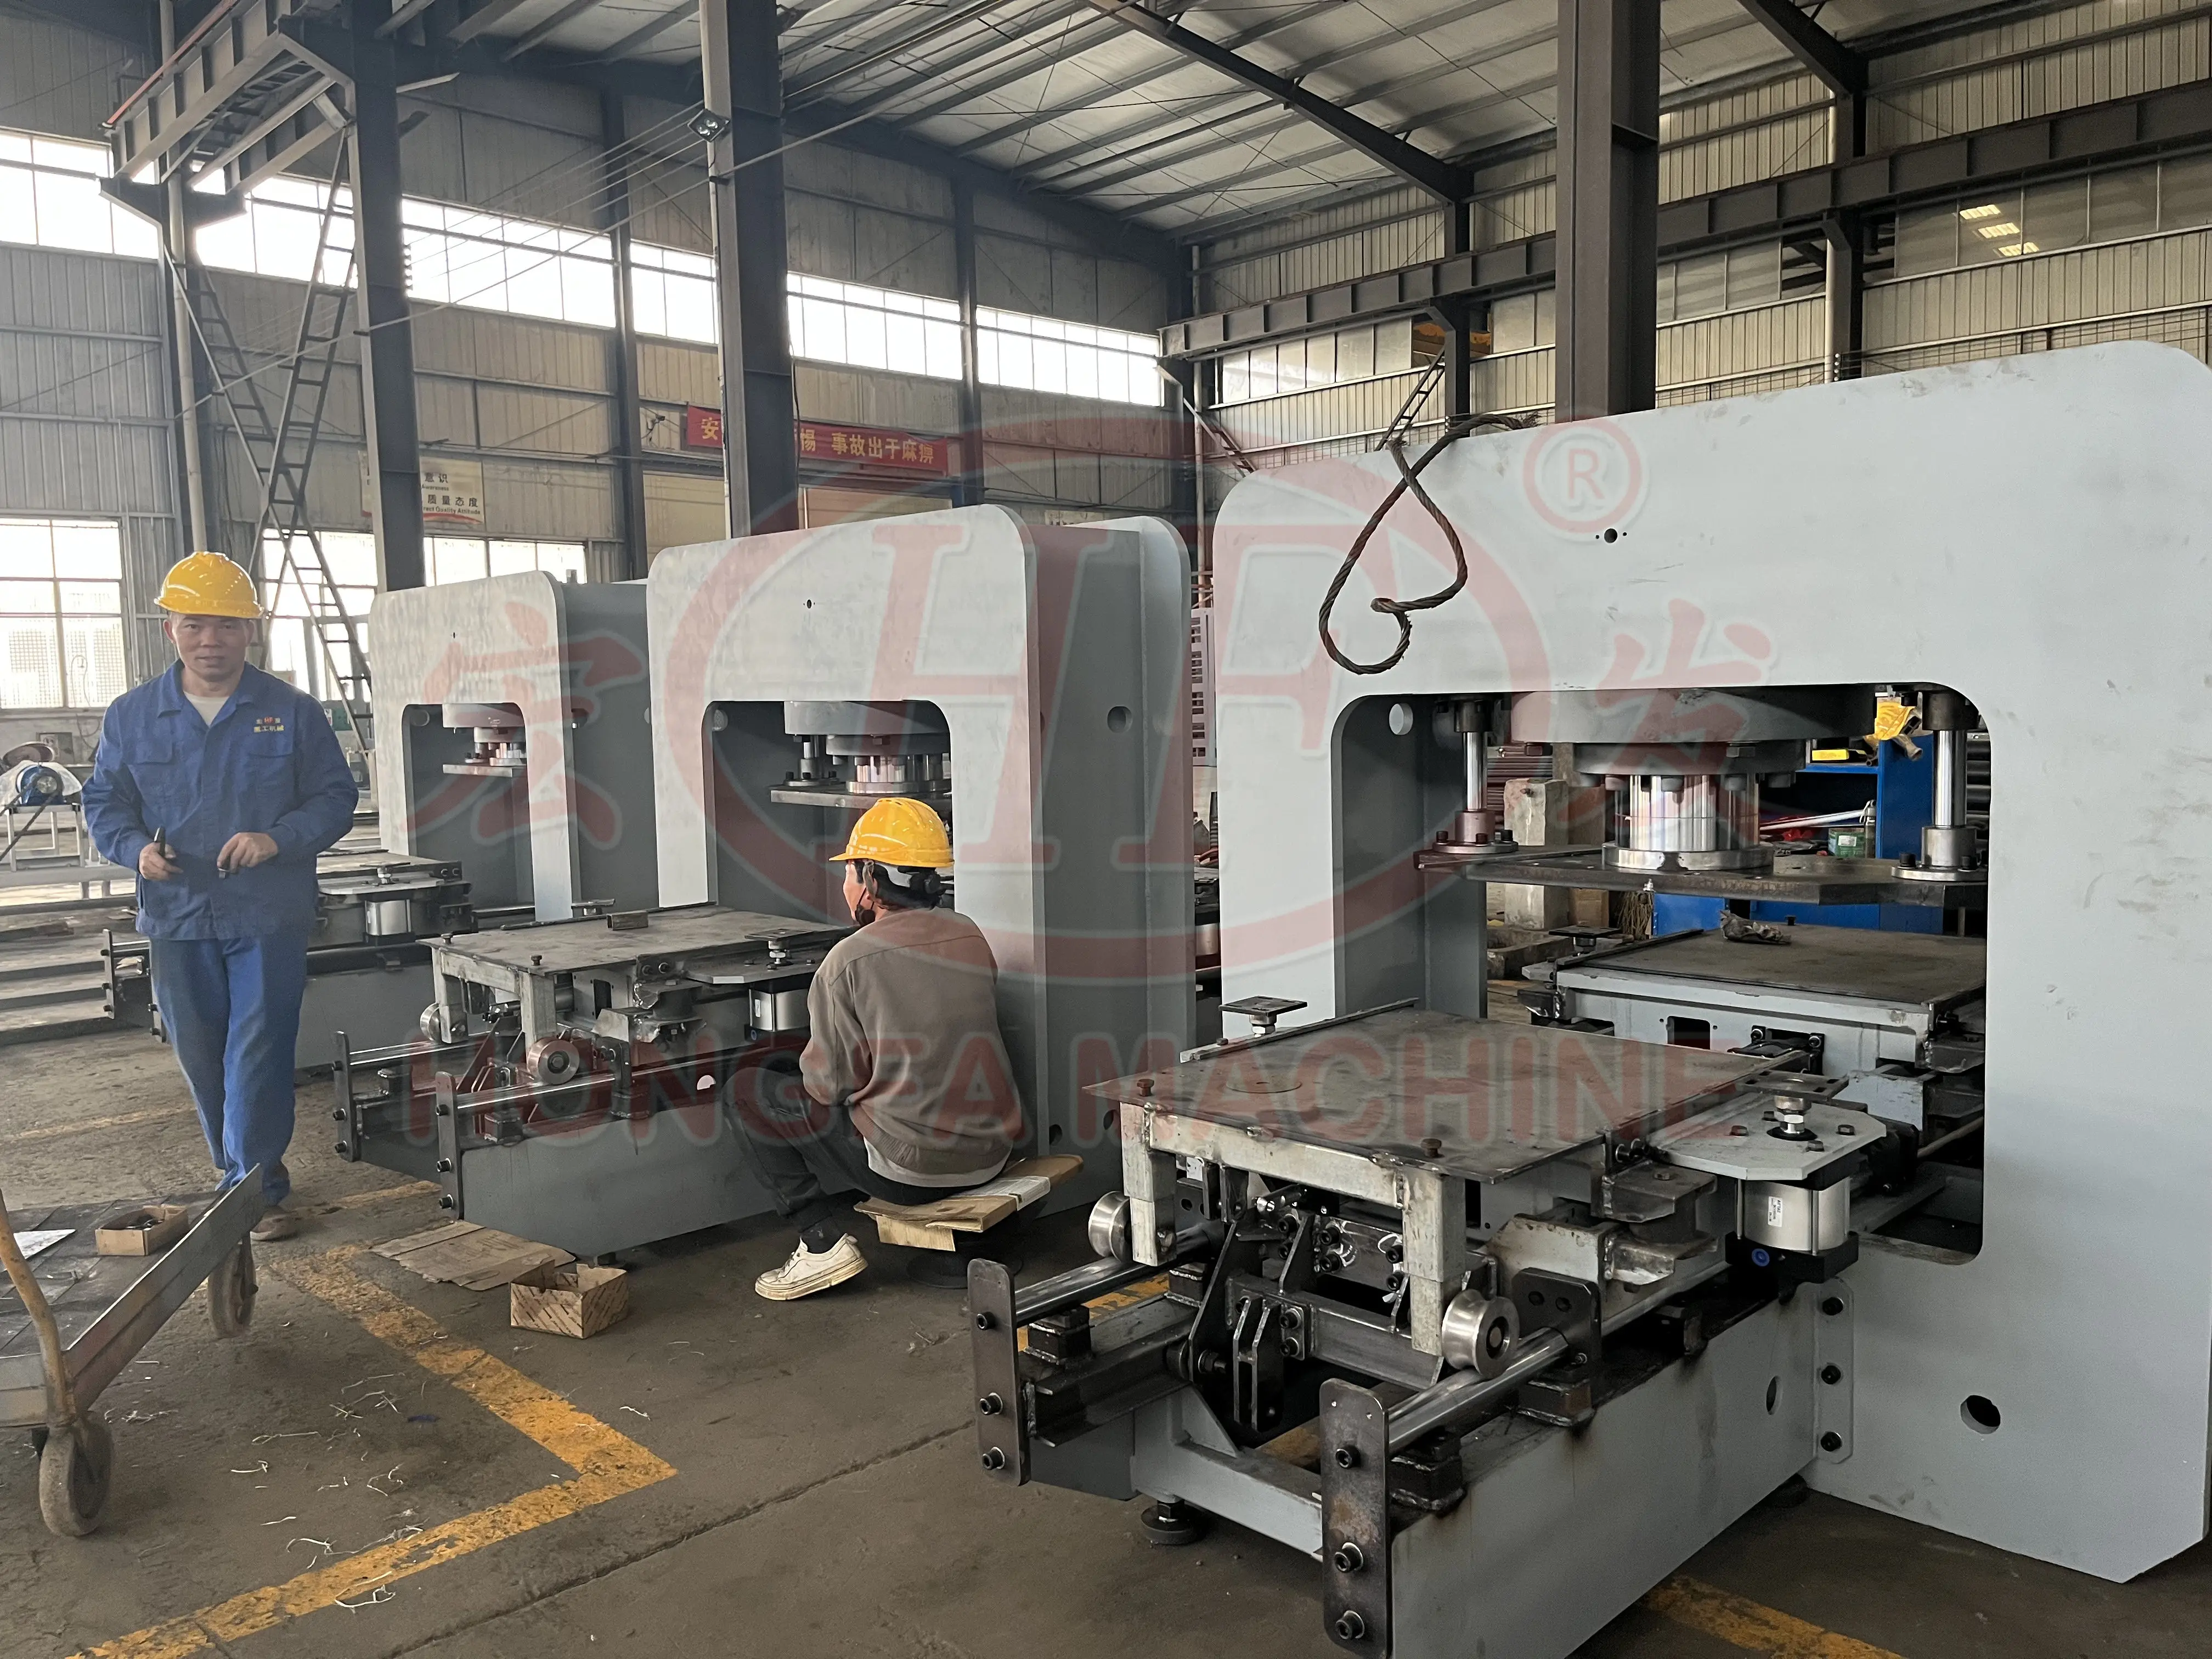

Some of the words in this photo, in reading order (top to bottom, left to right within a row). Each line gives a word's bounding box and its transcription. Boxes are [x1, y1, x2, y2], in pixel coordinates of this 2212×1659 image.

[701, 417, 719, 440] 安
[831, 432, 934, 464] 事故出于麻痹
[428, 494, 478, 507] 质量态度
[436, 506, 456, 514] Quality
